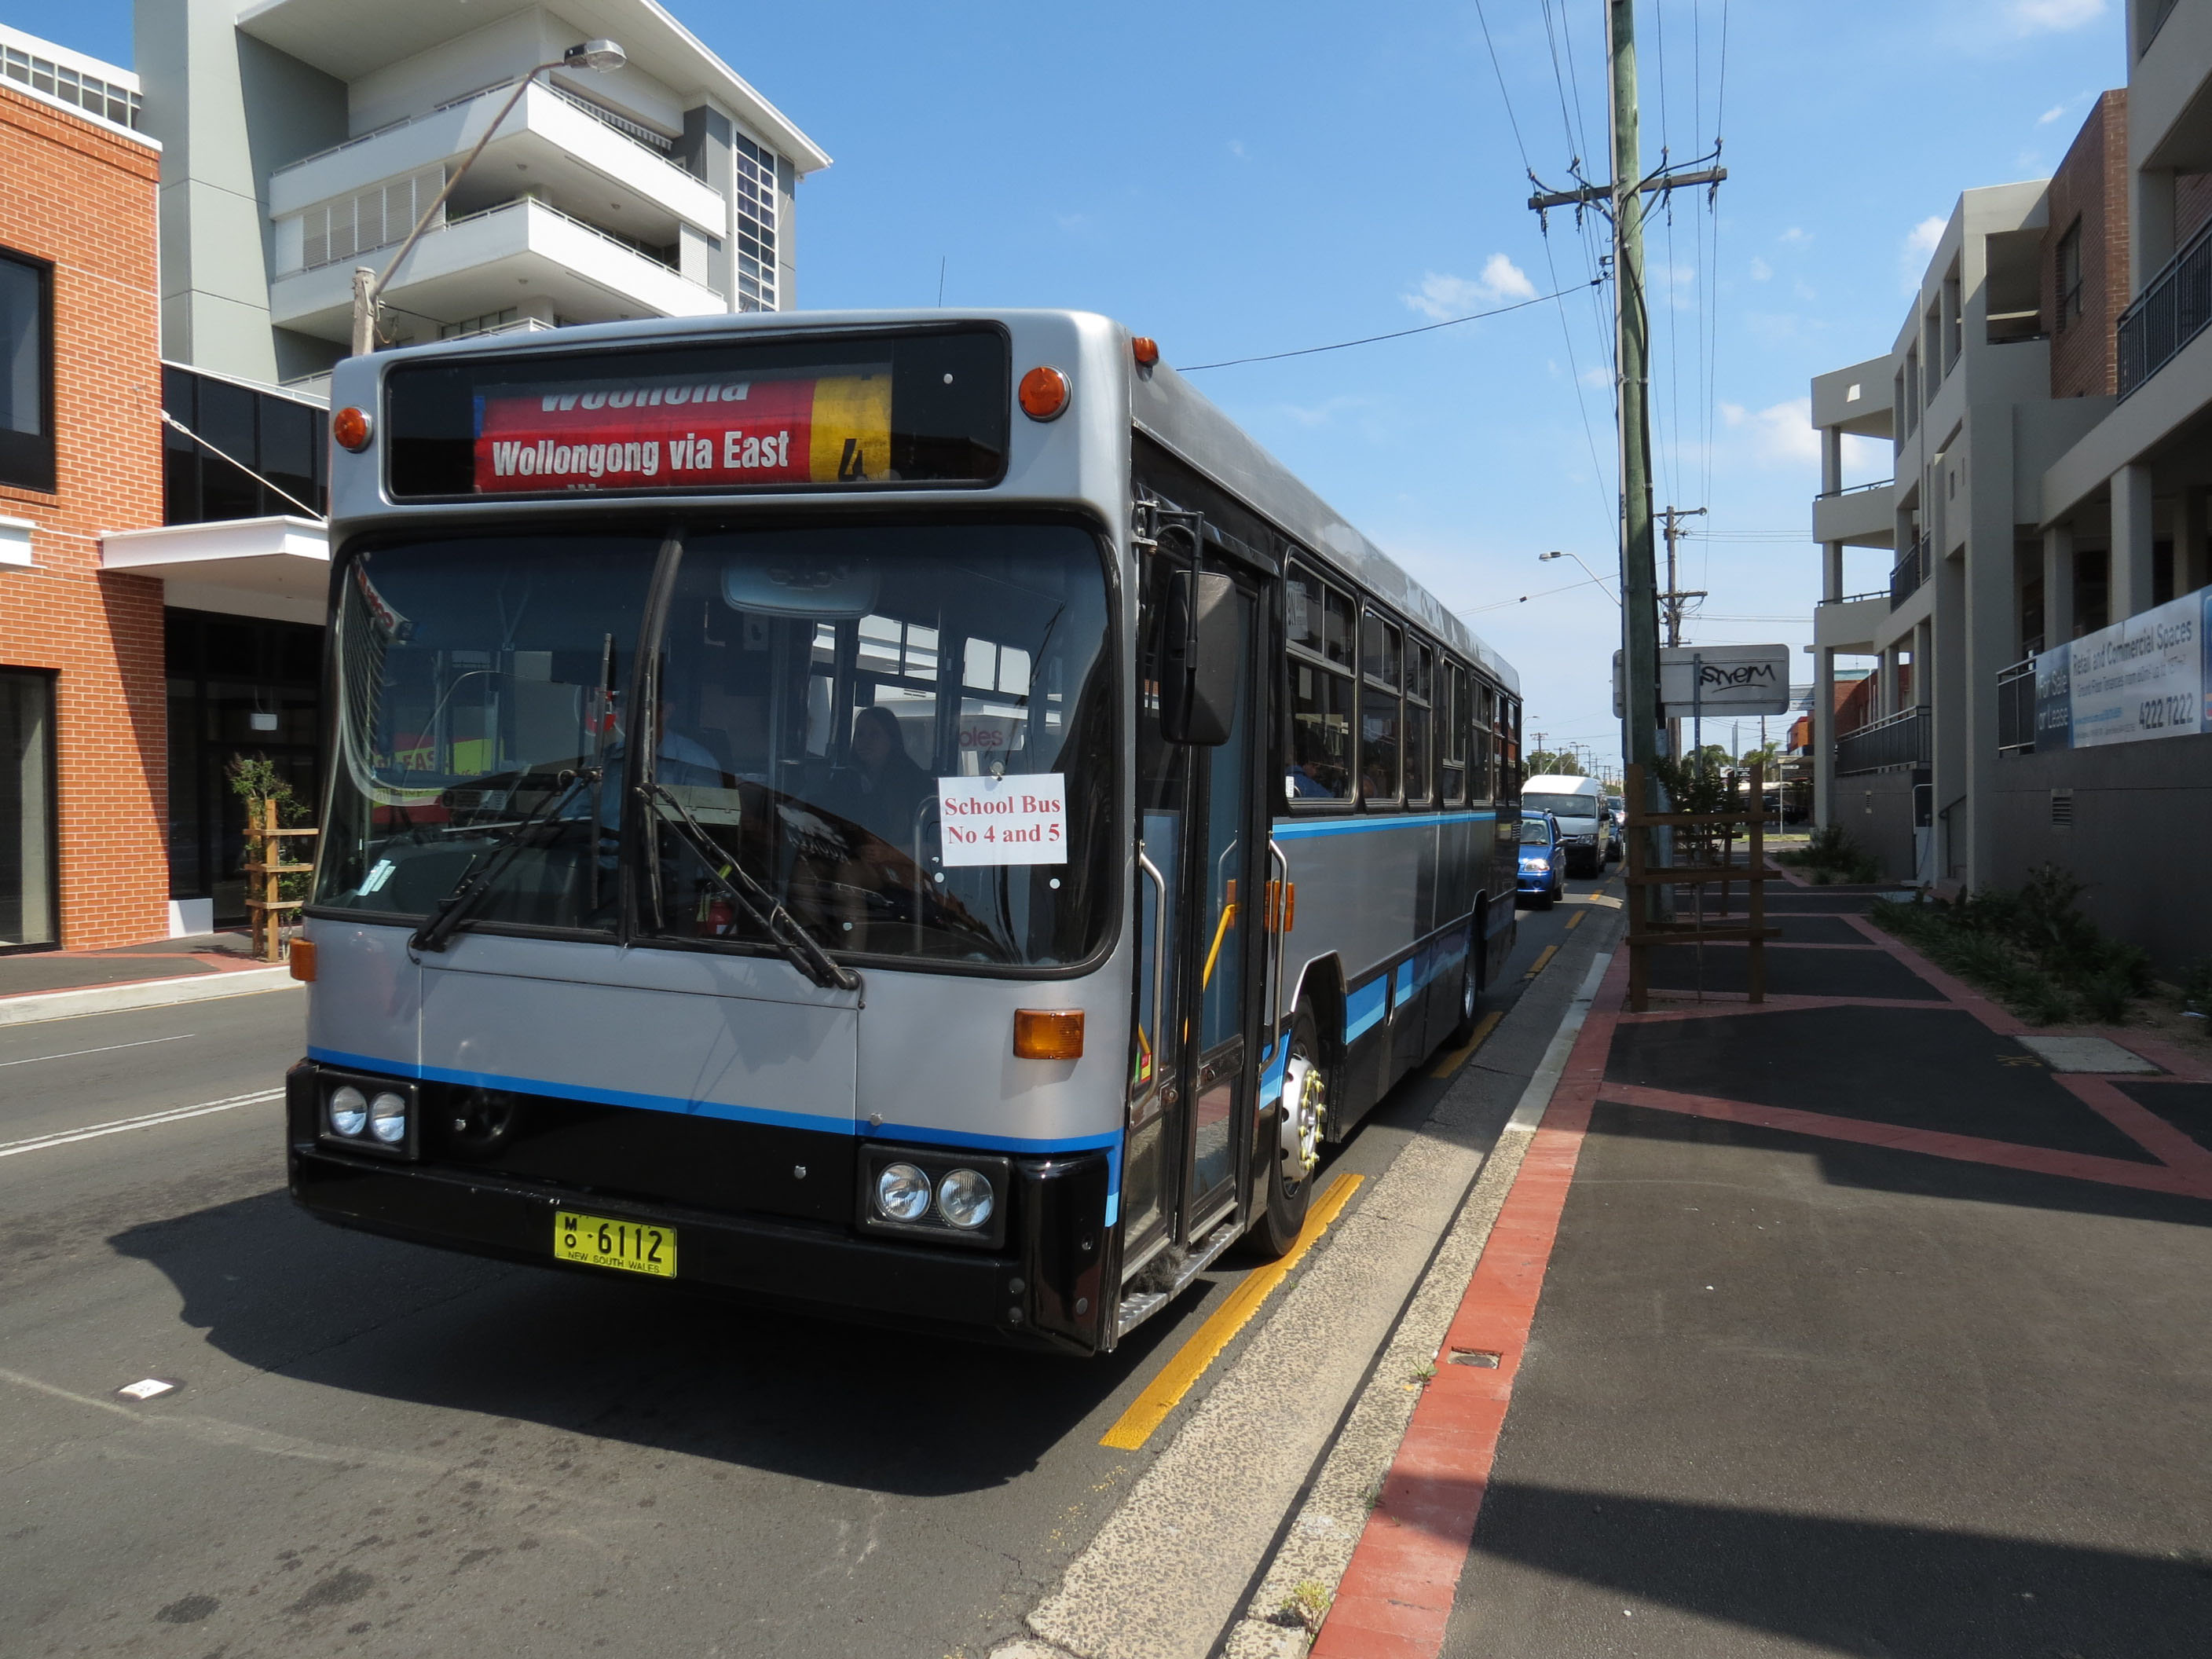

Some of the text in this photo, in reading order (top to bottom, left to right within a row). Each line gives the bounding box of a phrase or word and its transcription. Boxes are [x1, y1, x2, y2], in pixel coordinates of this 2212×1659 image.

[493, 430, 789, 478] Wollongong via East
[2073, 652, 2092, 676] Retail
[2093, 643, 2105, 671] and
[2107, 626, 2155, 666] Commercial
[2157, 620, 2192, 657] Spaces
[2039, 668, 2067, 699] For Sale
[2048, 703, 2068, 729] Lease
[2139, 698, 2164, 731] 4222
[2166, 692, 2194, 727] 7222
[959, 726, 1004, 747] oles
[945, 795, 1061, 816] School Bus
[947, 823, 1060, 844] No 4 and 5
[598, 1223, 663, 1263] 6112
[568, 1251, 660, 1274] NEW SOUTH WALES
